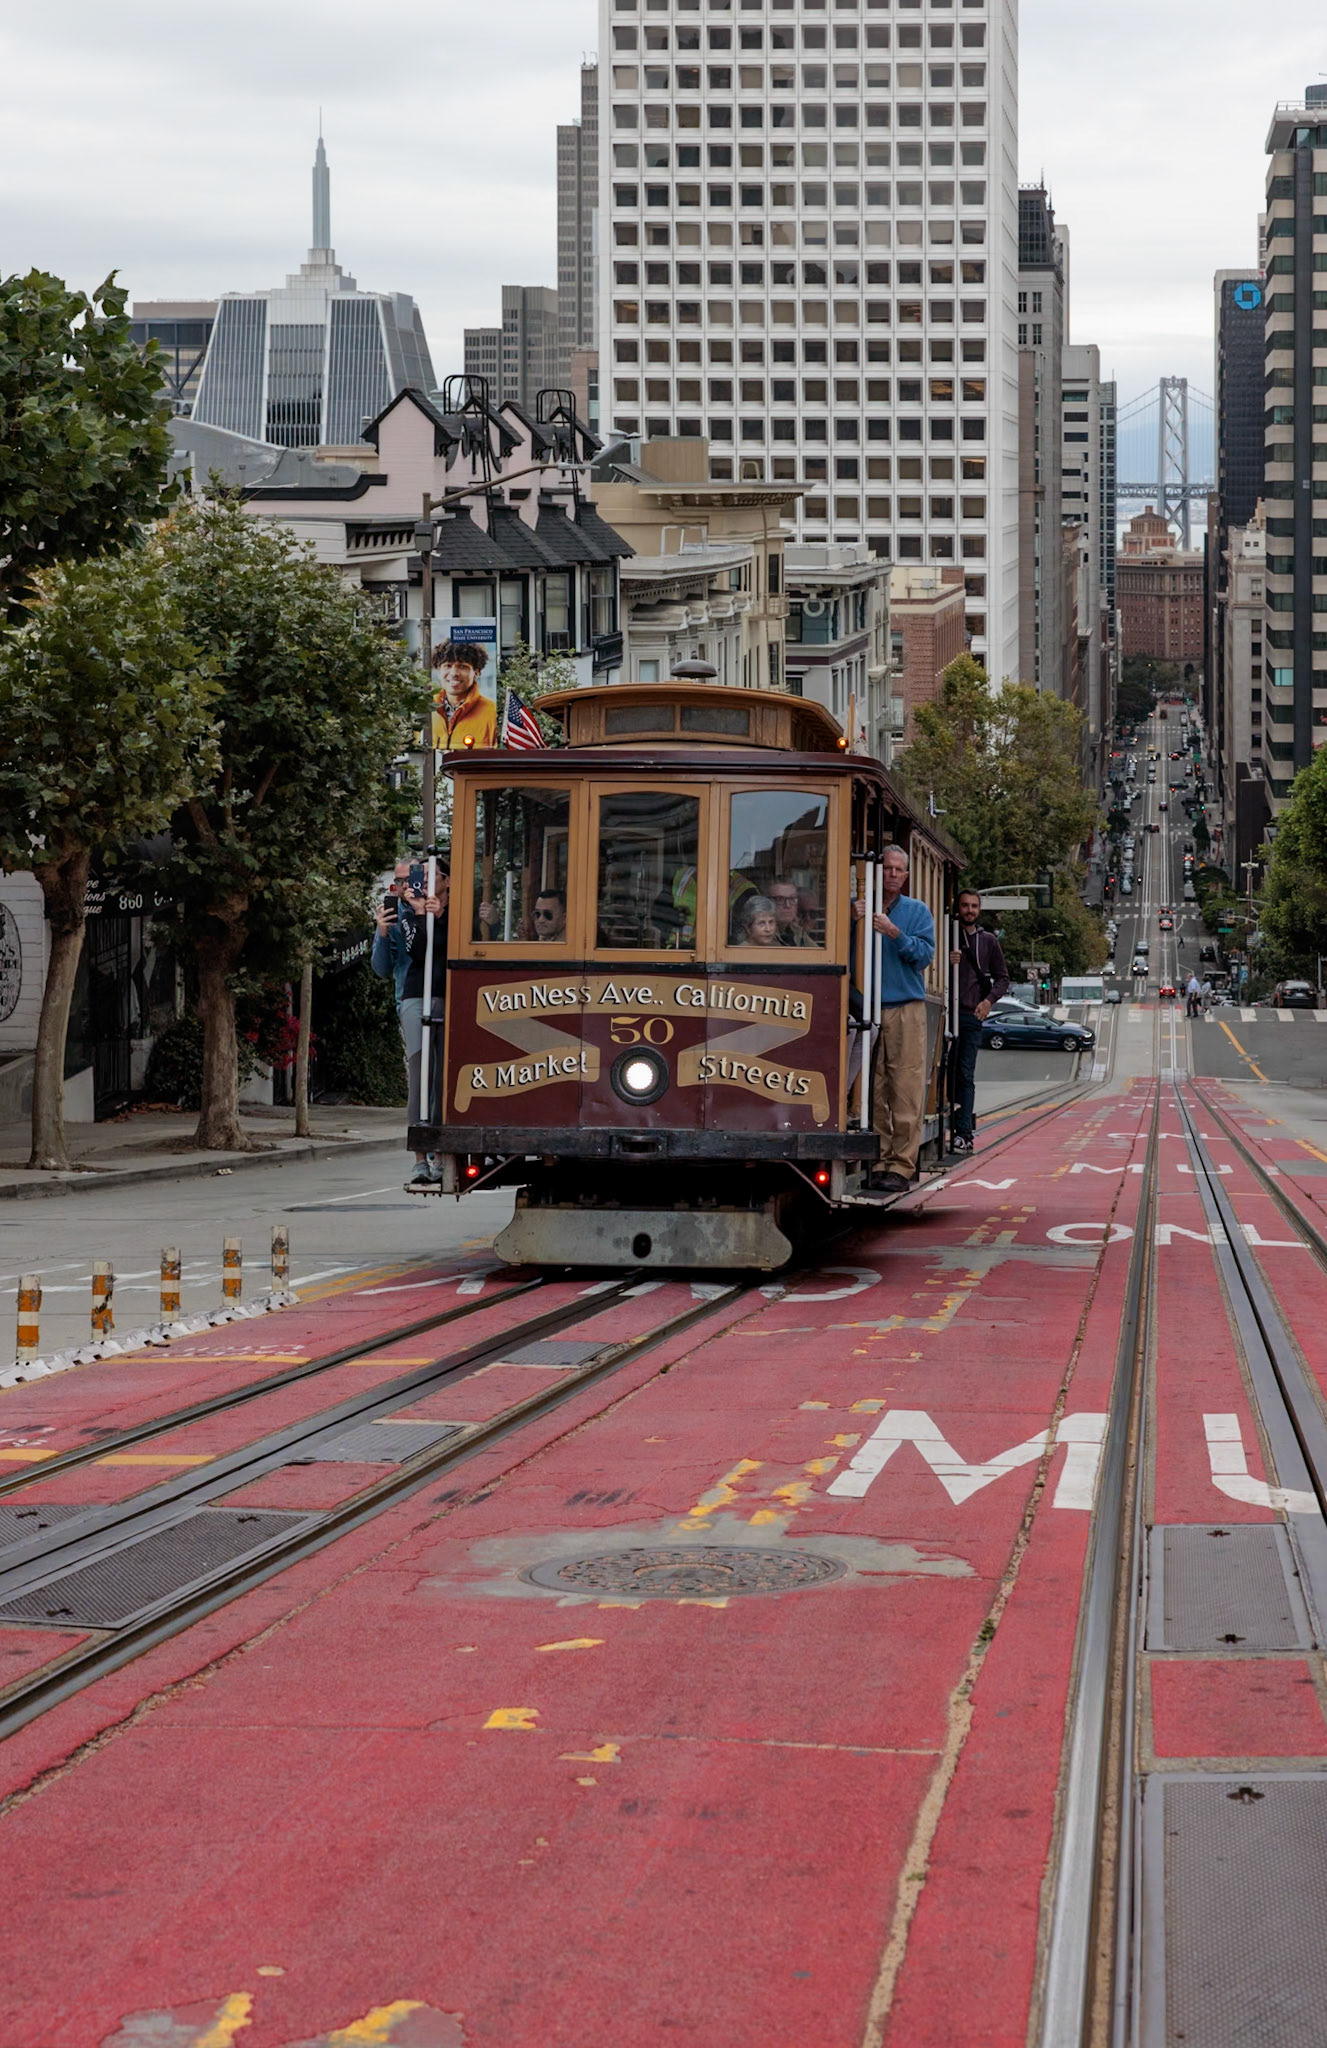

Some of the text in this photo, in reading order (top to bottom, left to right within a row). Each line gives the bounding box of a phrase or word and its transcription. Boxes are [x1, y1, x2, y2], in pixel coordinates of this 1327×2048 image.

[483, 990, 527, 1013] Van
[531, 984, 592, 1008] Ness
[674, 984, 806, 1020] California
[610, 1016, 674, 1045] 50
[472, 1050, 588, 1089] & Market
[699, 1055, 812, 1095] Streets
